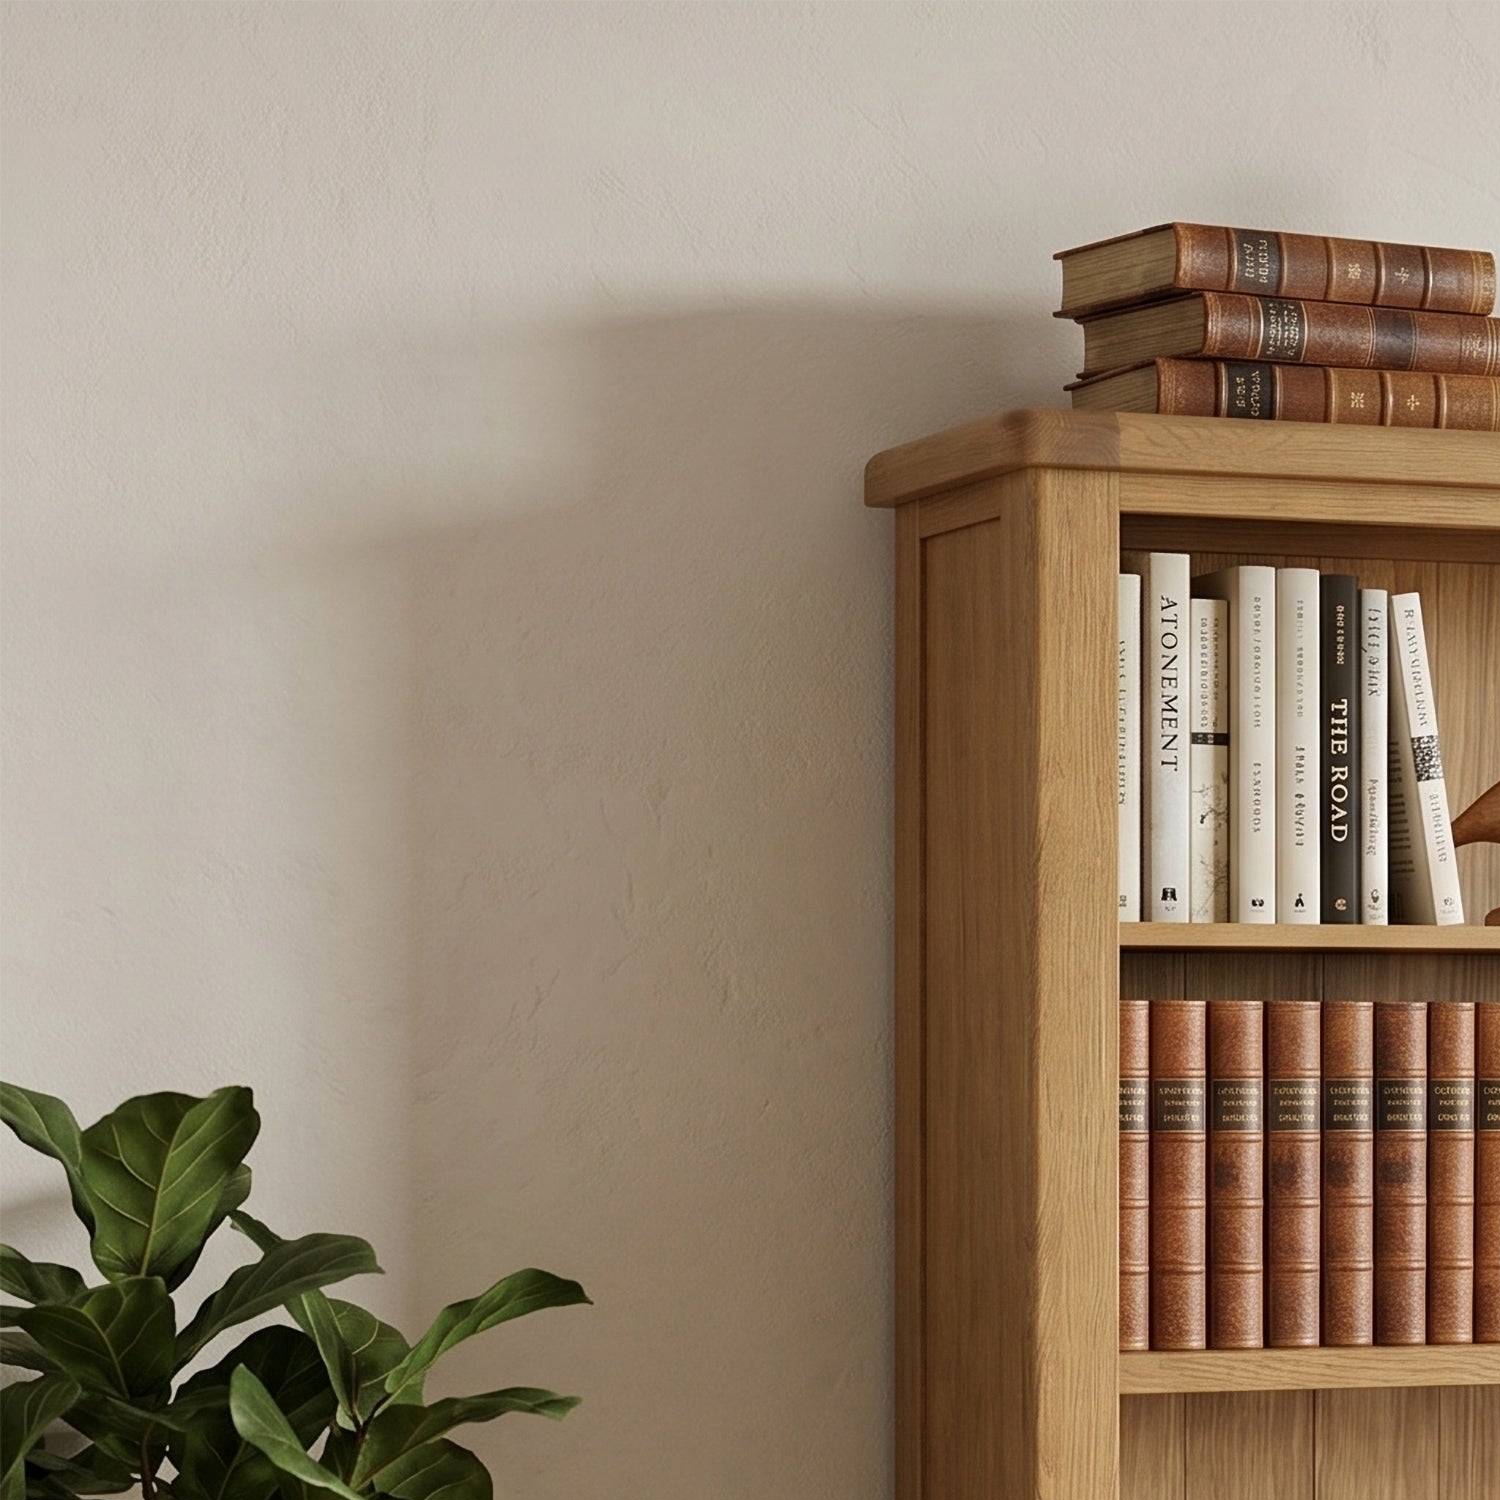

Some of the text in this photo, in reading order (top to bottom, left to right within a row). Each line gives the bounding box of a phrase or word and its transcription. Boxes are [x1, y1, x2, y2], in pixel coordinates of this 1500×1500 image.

[1160, 595, 1178, 772] ATONEMENT
[1331, 699, 1349, 842] THE ROAD
